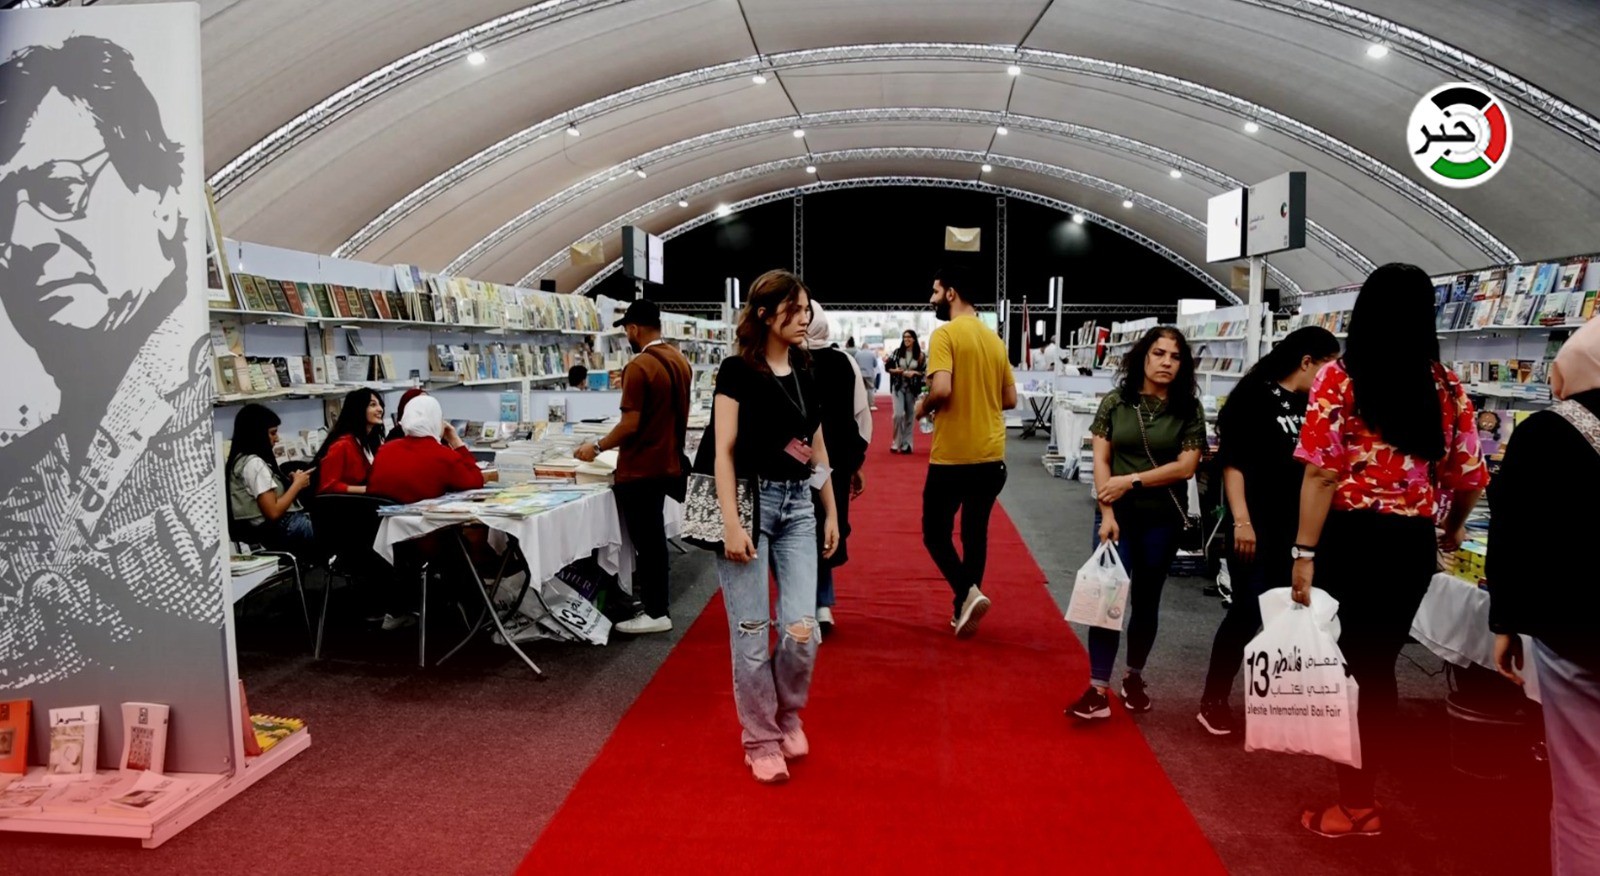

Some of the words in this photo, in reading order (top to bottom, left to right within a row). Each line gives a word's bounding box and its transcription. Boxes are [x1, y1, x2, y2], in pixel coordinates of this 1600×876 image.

[558, 607, 588, 631] 13
[1246, 650, 1270, 698] 13
[1272, 645, 1302, 679] فلطين
[1325, 704, 1341, 718] Fair
